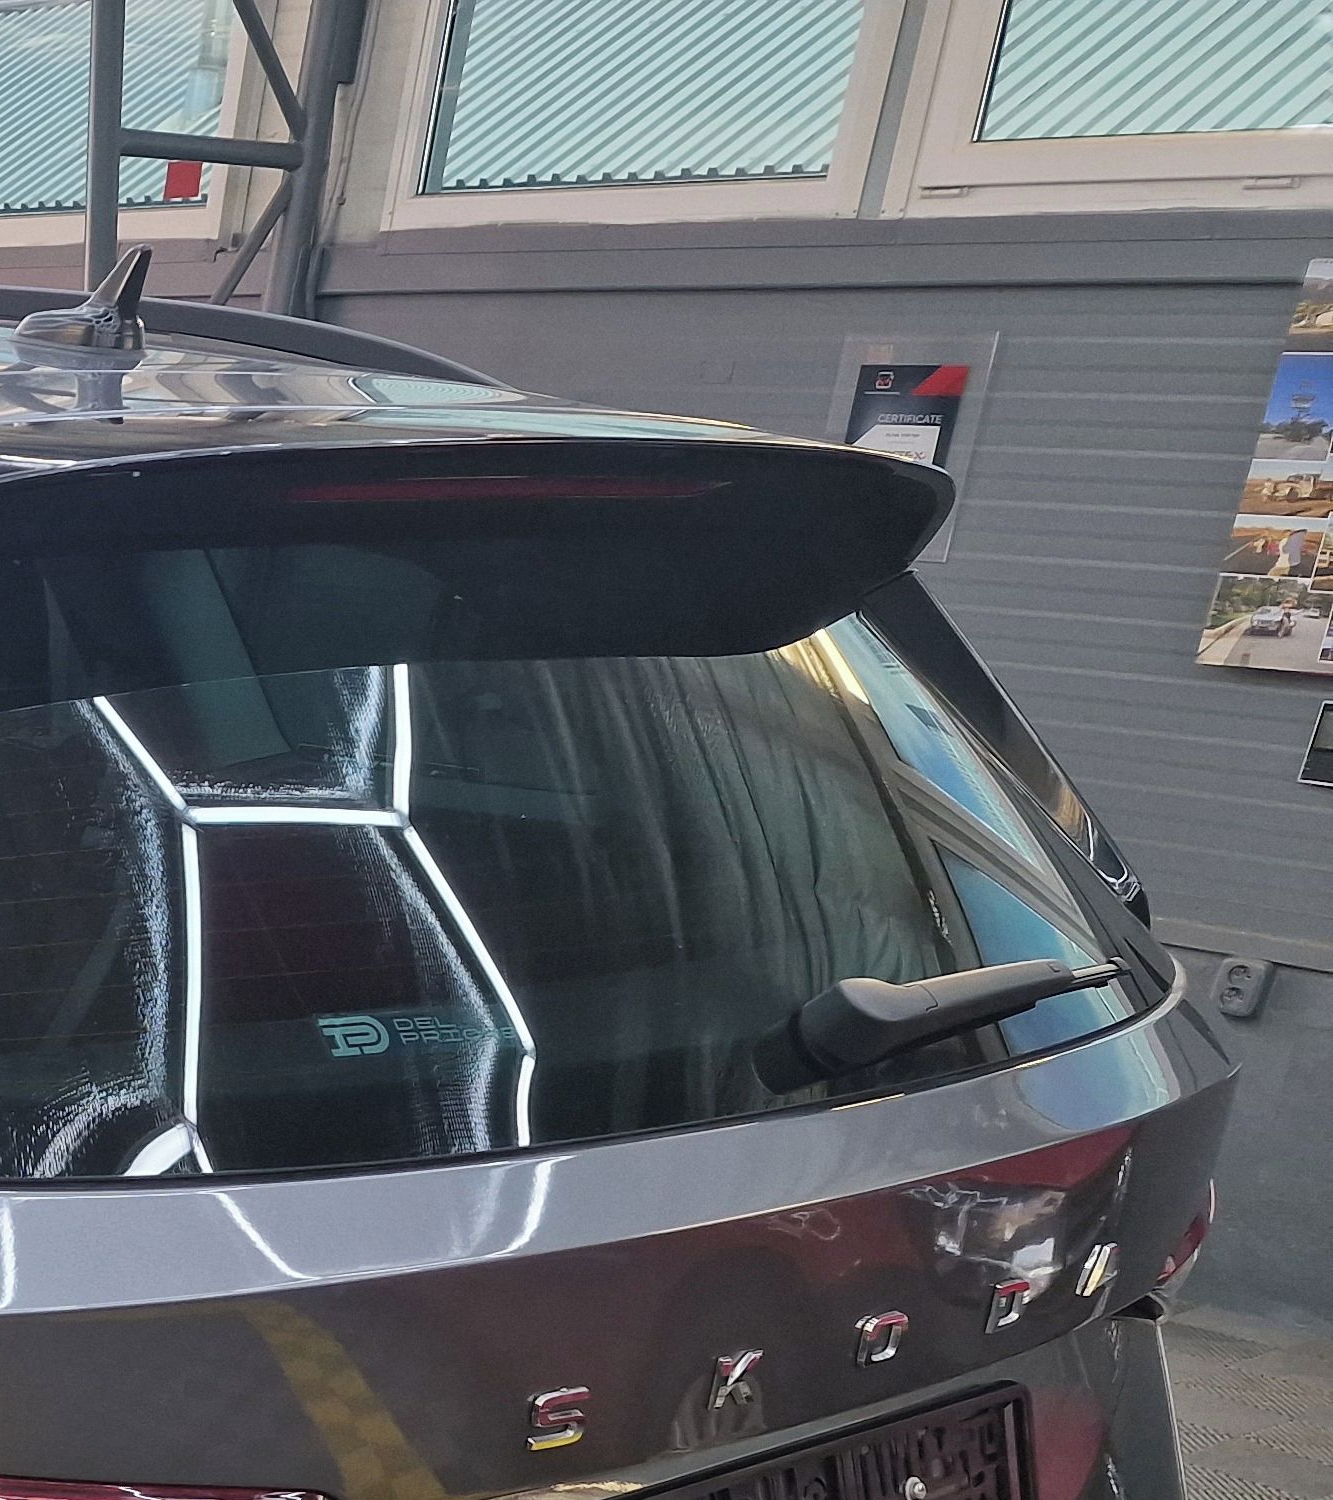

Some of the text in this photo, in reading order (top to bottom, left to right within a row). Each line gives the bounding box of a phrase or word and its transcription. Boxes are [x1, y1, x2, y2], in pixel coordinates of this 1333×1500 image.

[877, 413, 944, 424] CERTIFICATE
[393, 1016, 457, 1031] DEL
[526, 1242, 1120, 1451] SKODA
